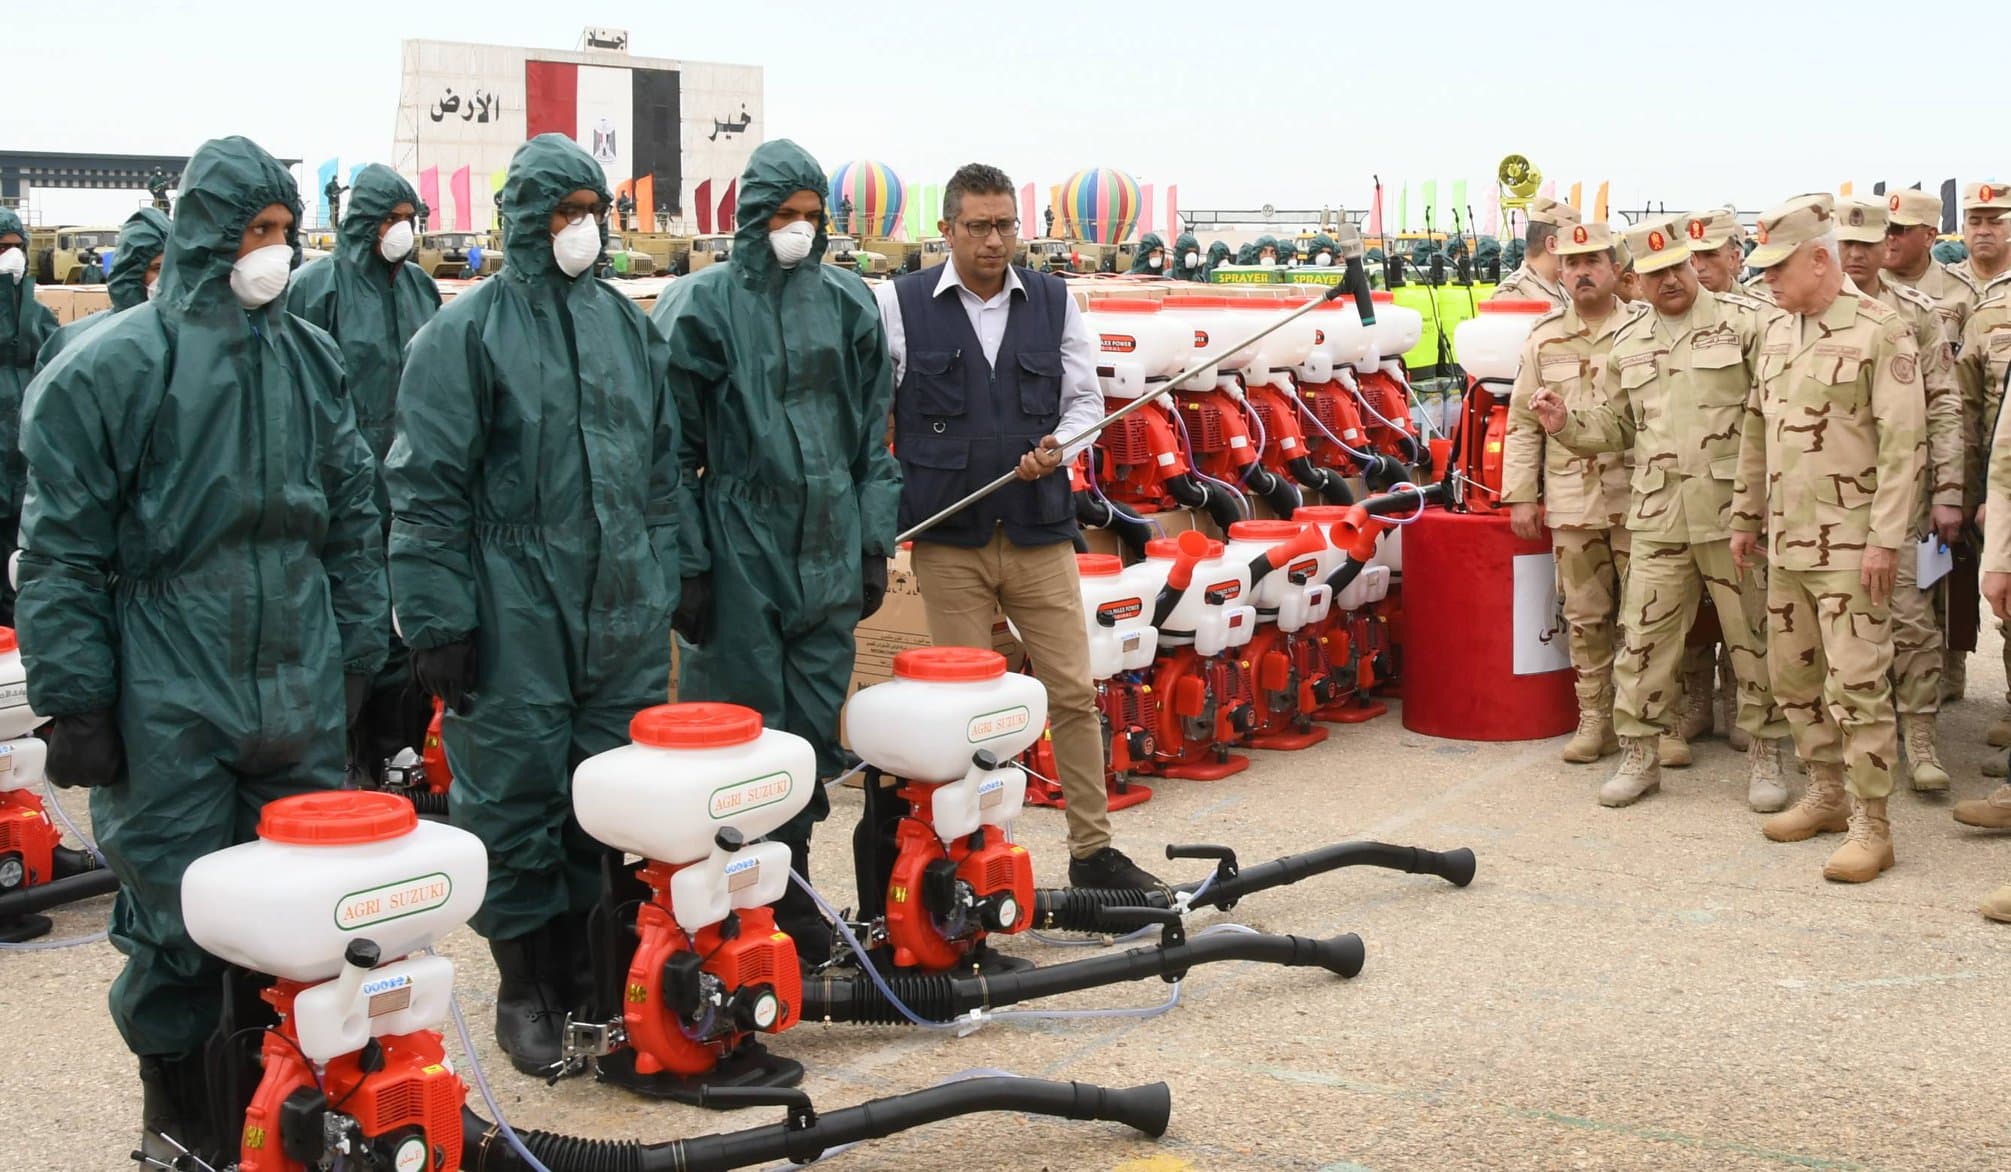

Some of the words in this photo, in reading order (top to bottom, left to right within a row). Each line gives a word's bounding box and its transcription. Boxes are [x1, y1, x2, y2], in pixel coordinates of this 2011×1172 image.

[430, 87, 499, 123] الأرض
[708, 102, 751, 142] خير
[1218, 273, 1269, 283] SPRAYER
[971, 721, 992, 737] AGRI
[996, 713, 1026, 730] SUZUKI
[715, 792, 741, 811] AGRI
[747, 779, 787, 802] SUZUKI
[343, 898, 382, 921] AGRI
[389, 882, 445, 909] SUZUKI
